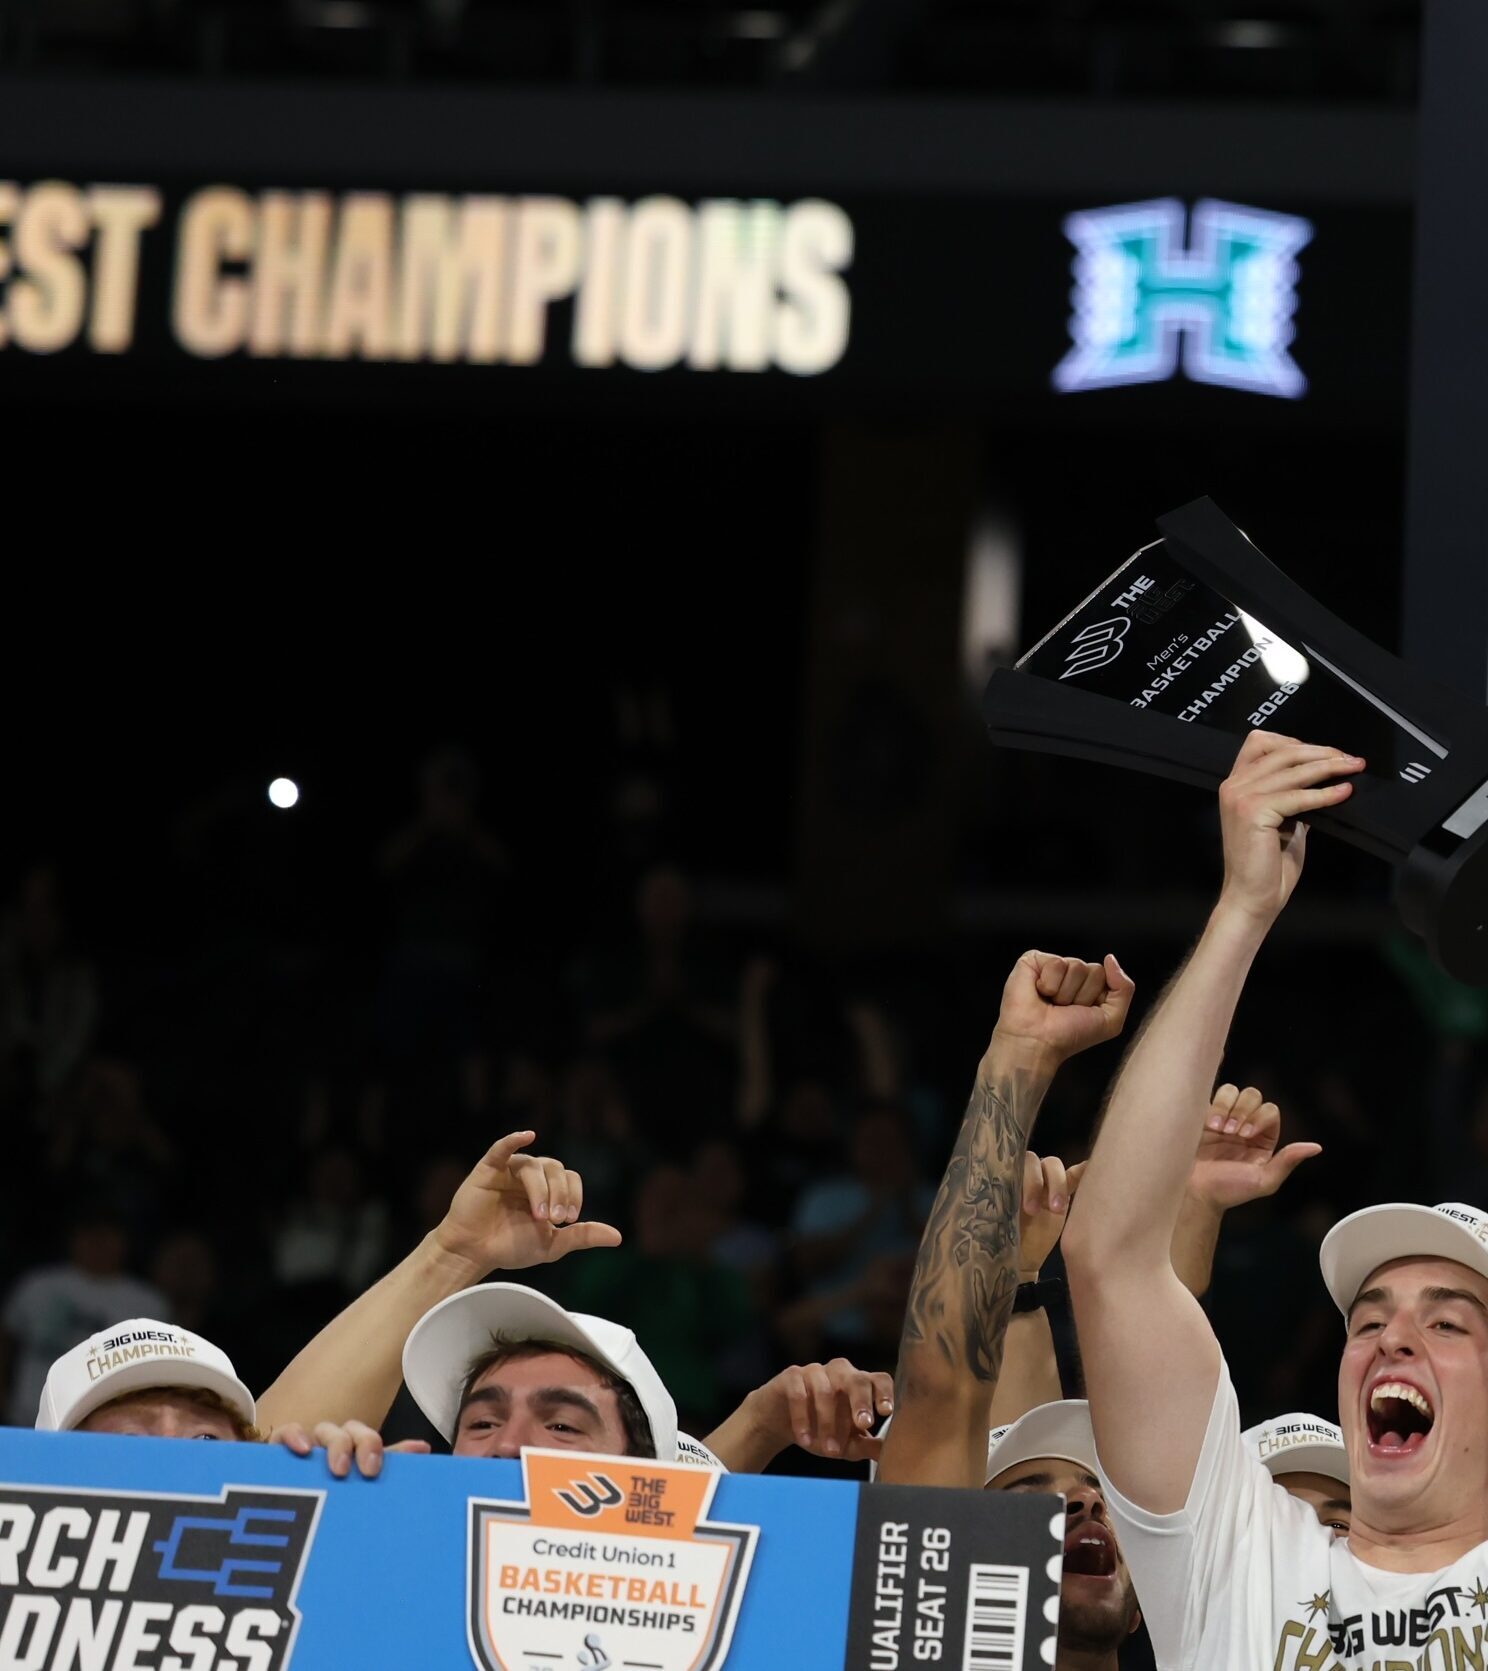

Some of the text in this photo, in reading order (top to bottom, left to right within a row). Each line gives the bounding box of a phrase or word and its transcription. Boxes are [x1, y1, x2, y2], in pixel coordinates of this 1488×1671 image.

[0, 181, 854, 376] ST CHAMPIONS
[1111, 574, 1155, 609] THE
[1146, 633, 1189, 671] Men's
[1177, 637, 1274, 722] CHAMPION
[1247, 681, 1300, 726] 2026
[103, 1334, 131, 1351] BIG
[1275, 1424, 1300, 1436] BIG
[629, 1492, 661, 1509] BIG
[630, 1476, 667, 1494] THE
[532, 1538, 597, 1561] Credit
[602, 1547, 663, 1567] Union
[500, 1564, 706, 1609] BASKETBALL
[912, 1527, 952, 1661] SEAT 26
[502, 1597, 696, 1632] CHAMPIONSHIPS
